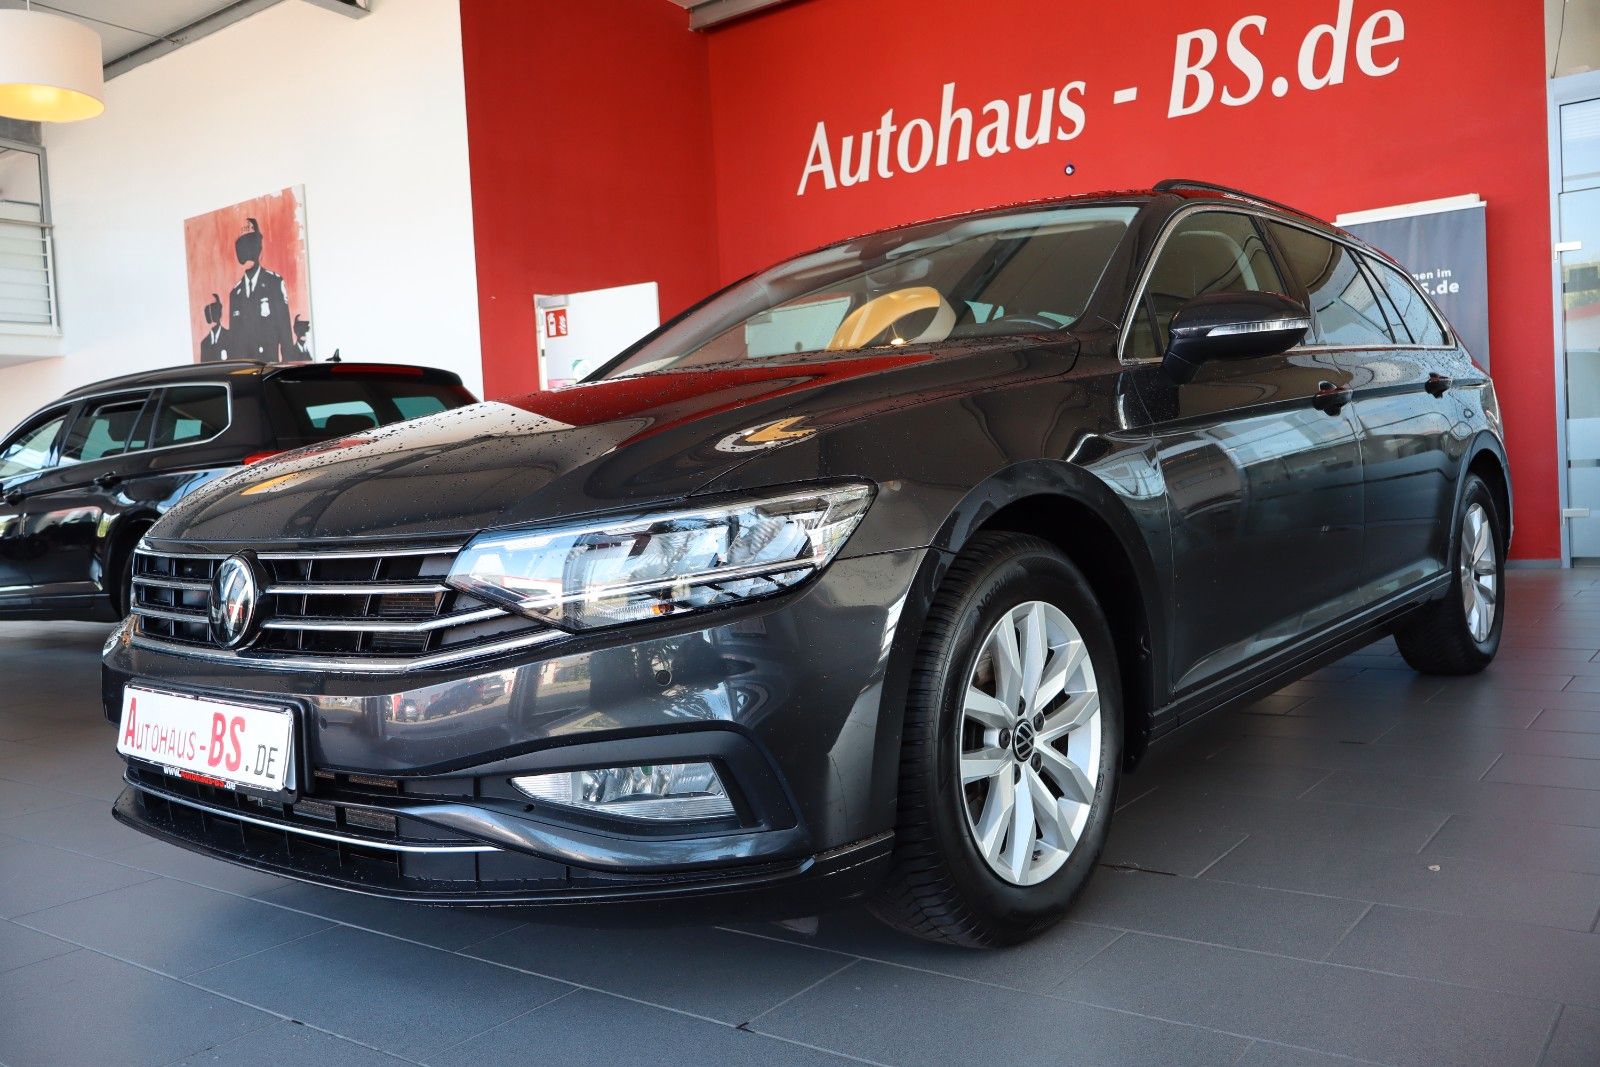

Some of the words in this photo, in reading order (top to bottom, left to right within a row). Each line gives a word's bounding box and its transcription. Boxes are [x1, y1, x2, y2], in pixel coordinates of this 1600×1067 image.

[797, 81, 1087, 196] Autohaus
[1113, 86, 1138, 105] -
[1167, 0, 1406, 119] BS.de
[1436, 268, 1452, 278] im
